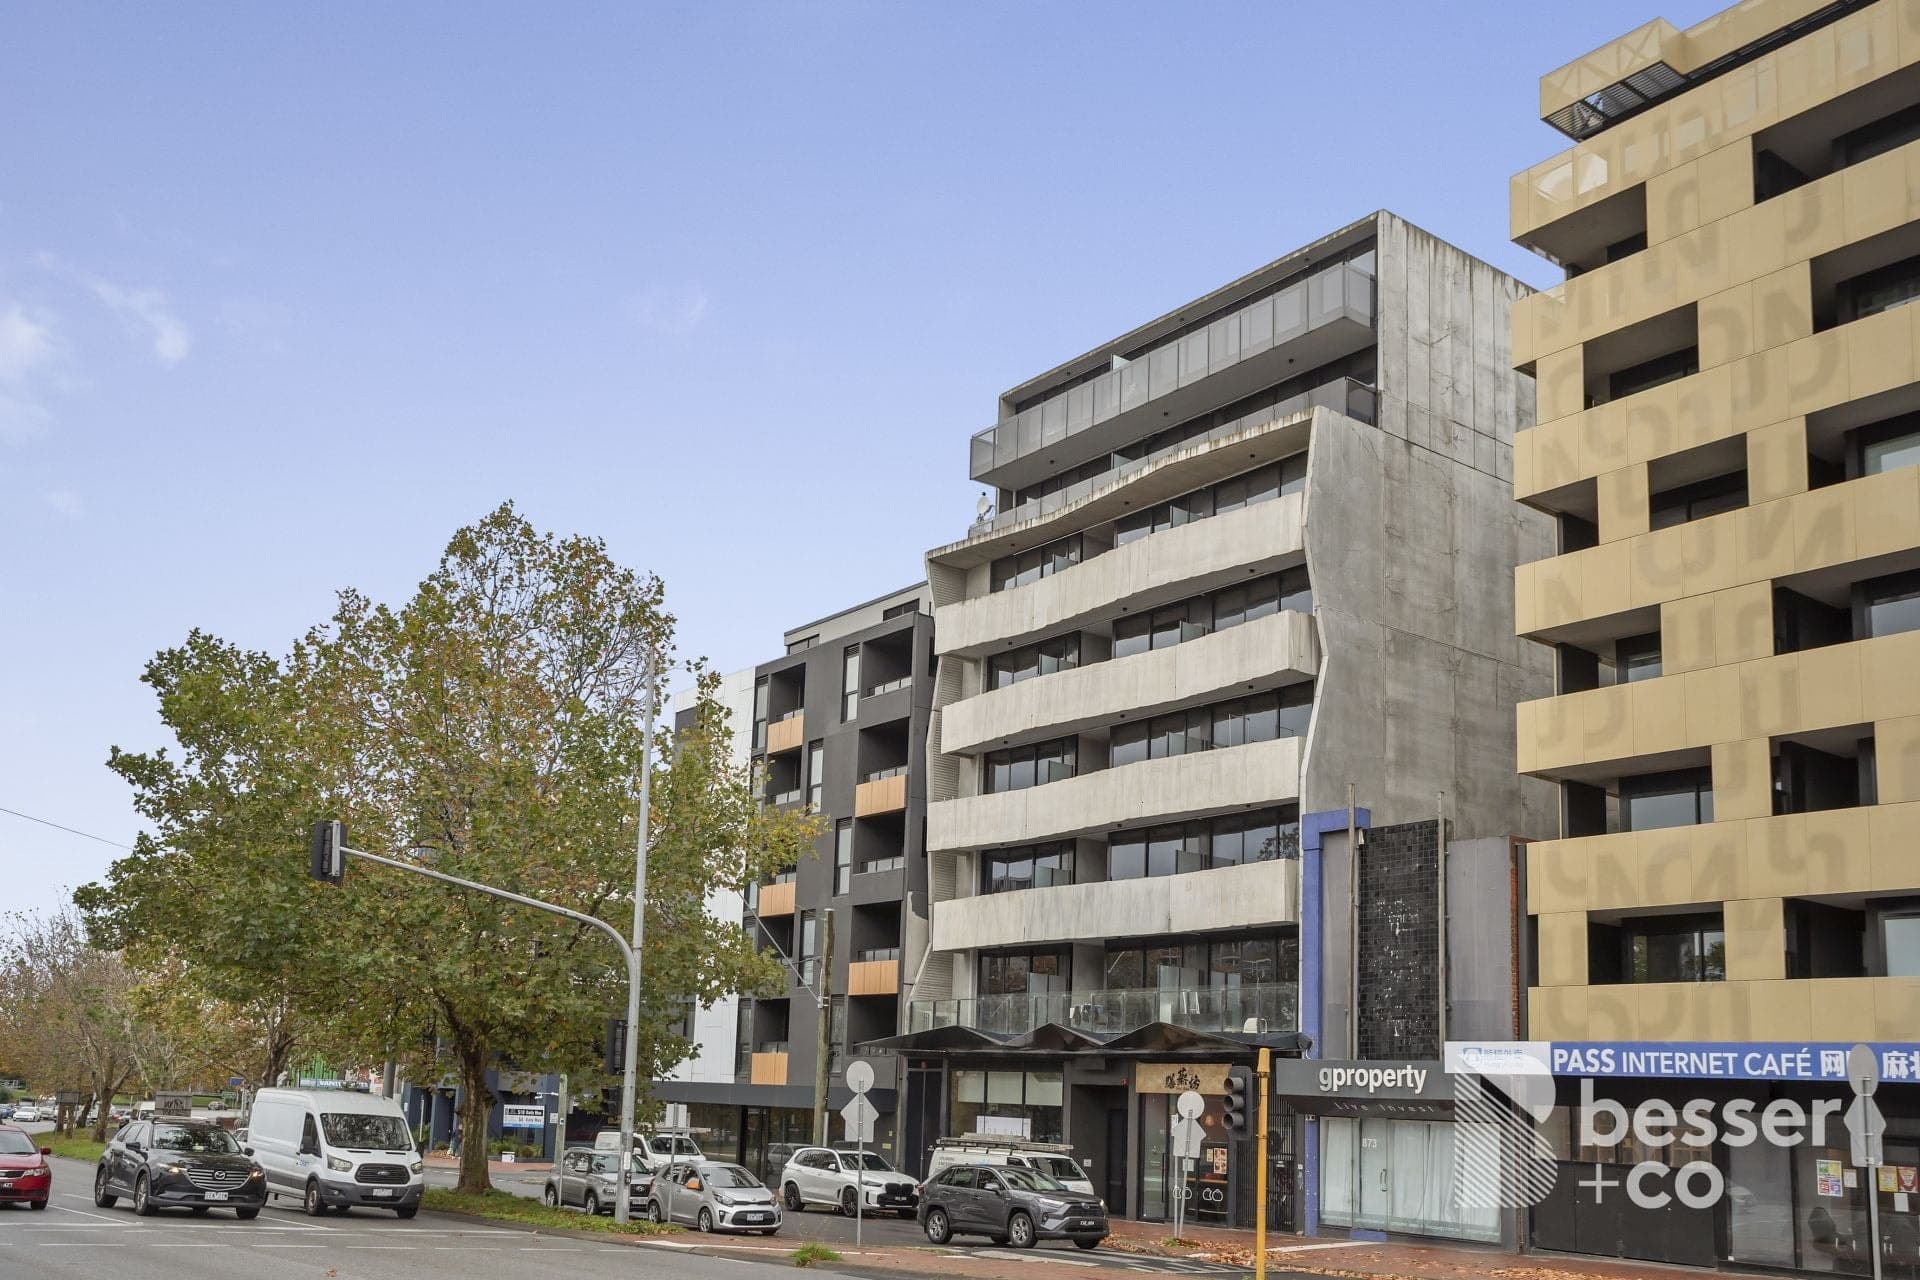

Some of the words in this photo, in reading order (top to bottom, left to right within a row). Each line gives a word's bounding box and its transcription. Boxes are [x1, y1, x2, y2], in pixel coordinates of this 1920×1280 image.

[1553, 1048, 1616, 1073] PASS
[1622, 1051, 1738, 1076] INTERNET
[1743, 1047, 1813, 1077] CAFÉ
[1819, 1050, 1850, 1078] 网
[1318, 1064, 1427, 1095] gproperty
